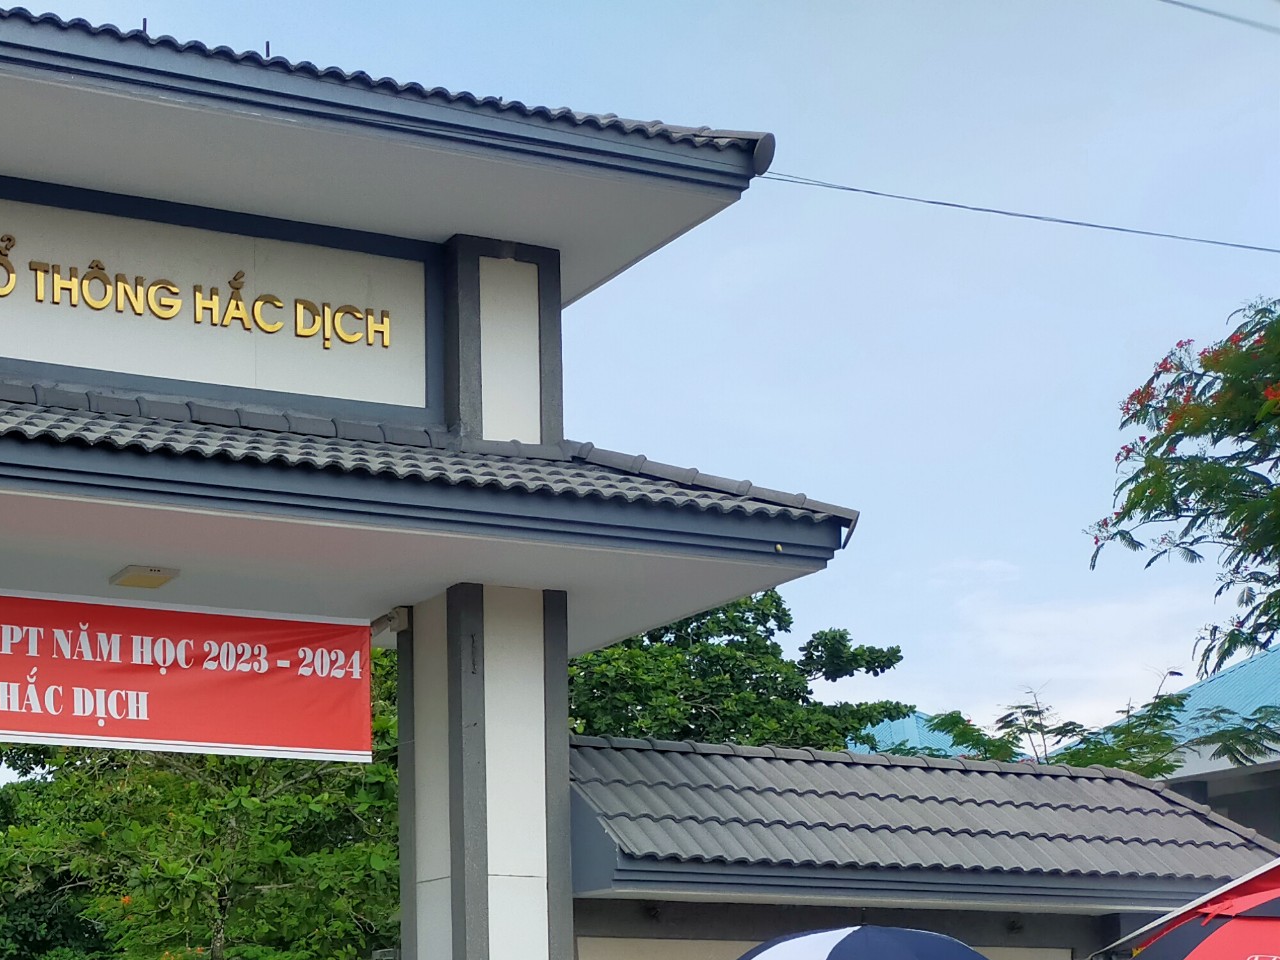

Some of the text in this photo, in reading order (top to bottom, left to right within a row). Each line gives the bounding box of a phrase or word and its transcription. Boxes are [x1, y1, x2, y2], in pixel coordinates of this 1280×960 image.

[29, 260, 183, 319] THÔNG
[193, 271, 284, 333] HẮC
[296, 299, 391, 349] DỊCH
[52, 622, 122, 663] NĂM
[131, 635, 195, 675] HỌC
[202, 640, 269, 674] 2023
[297, 647, 363, 679] 2024
[72, 686, 150, 727] DỊCH
